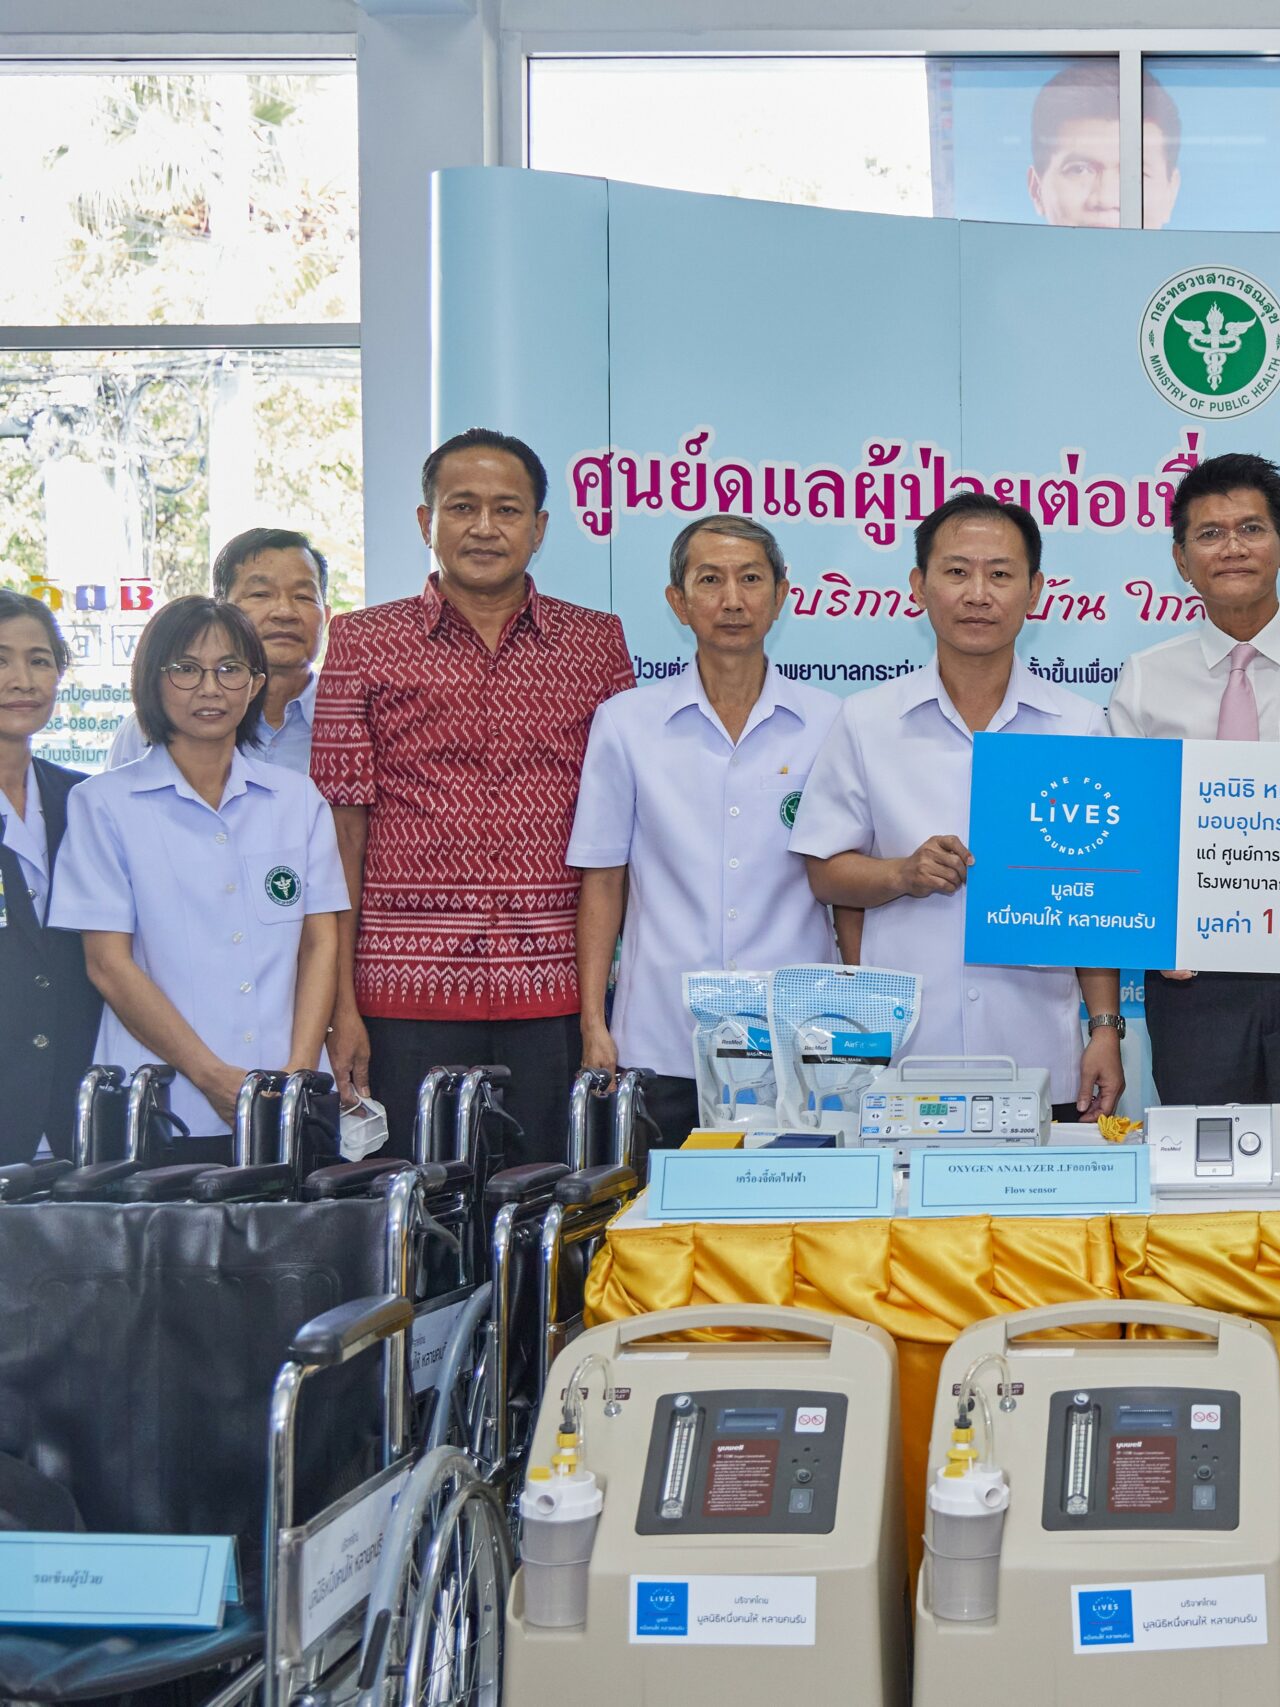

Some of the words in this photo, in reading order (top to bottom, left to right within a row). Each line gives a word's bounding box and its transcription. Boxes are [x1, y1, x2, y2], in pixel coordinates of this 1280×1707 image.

[1151, 272, 1280, 325] กระทรวงสาธารณสุข
[1150, 354, 1188, 401] MINISTRY
[1189, 397, 1205, 410] OF
[1209, 394, 1251, 412] PUBLIC
[1251, 357, 1280, 398] HEALTH
[1040, 776, 1070, 798] ONE
[1083, 776, 1112, 800] FOR
[1198, 777, 1256, 804] มูลนิธิ
[1040, 826, 1110, 856] FOUNDATION
[1196, 843, 1216, 861] แด่
[1051, 882, 1095, 902] มูลนิธิ
[986, 904, 1063, 927] หนึ่งคนให้
[1068, 912, 1156, 929] หลายคนรับ
[1196, 911, 1252, 939] มูลค่า
[948, 1164, 993, 1173] OXYGEN
[996, 1164, 1054, 1173] ANALYZER
[1004, 1186, 1025, 1194] Flow
